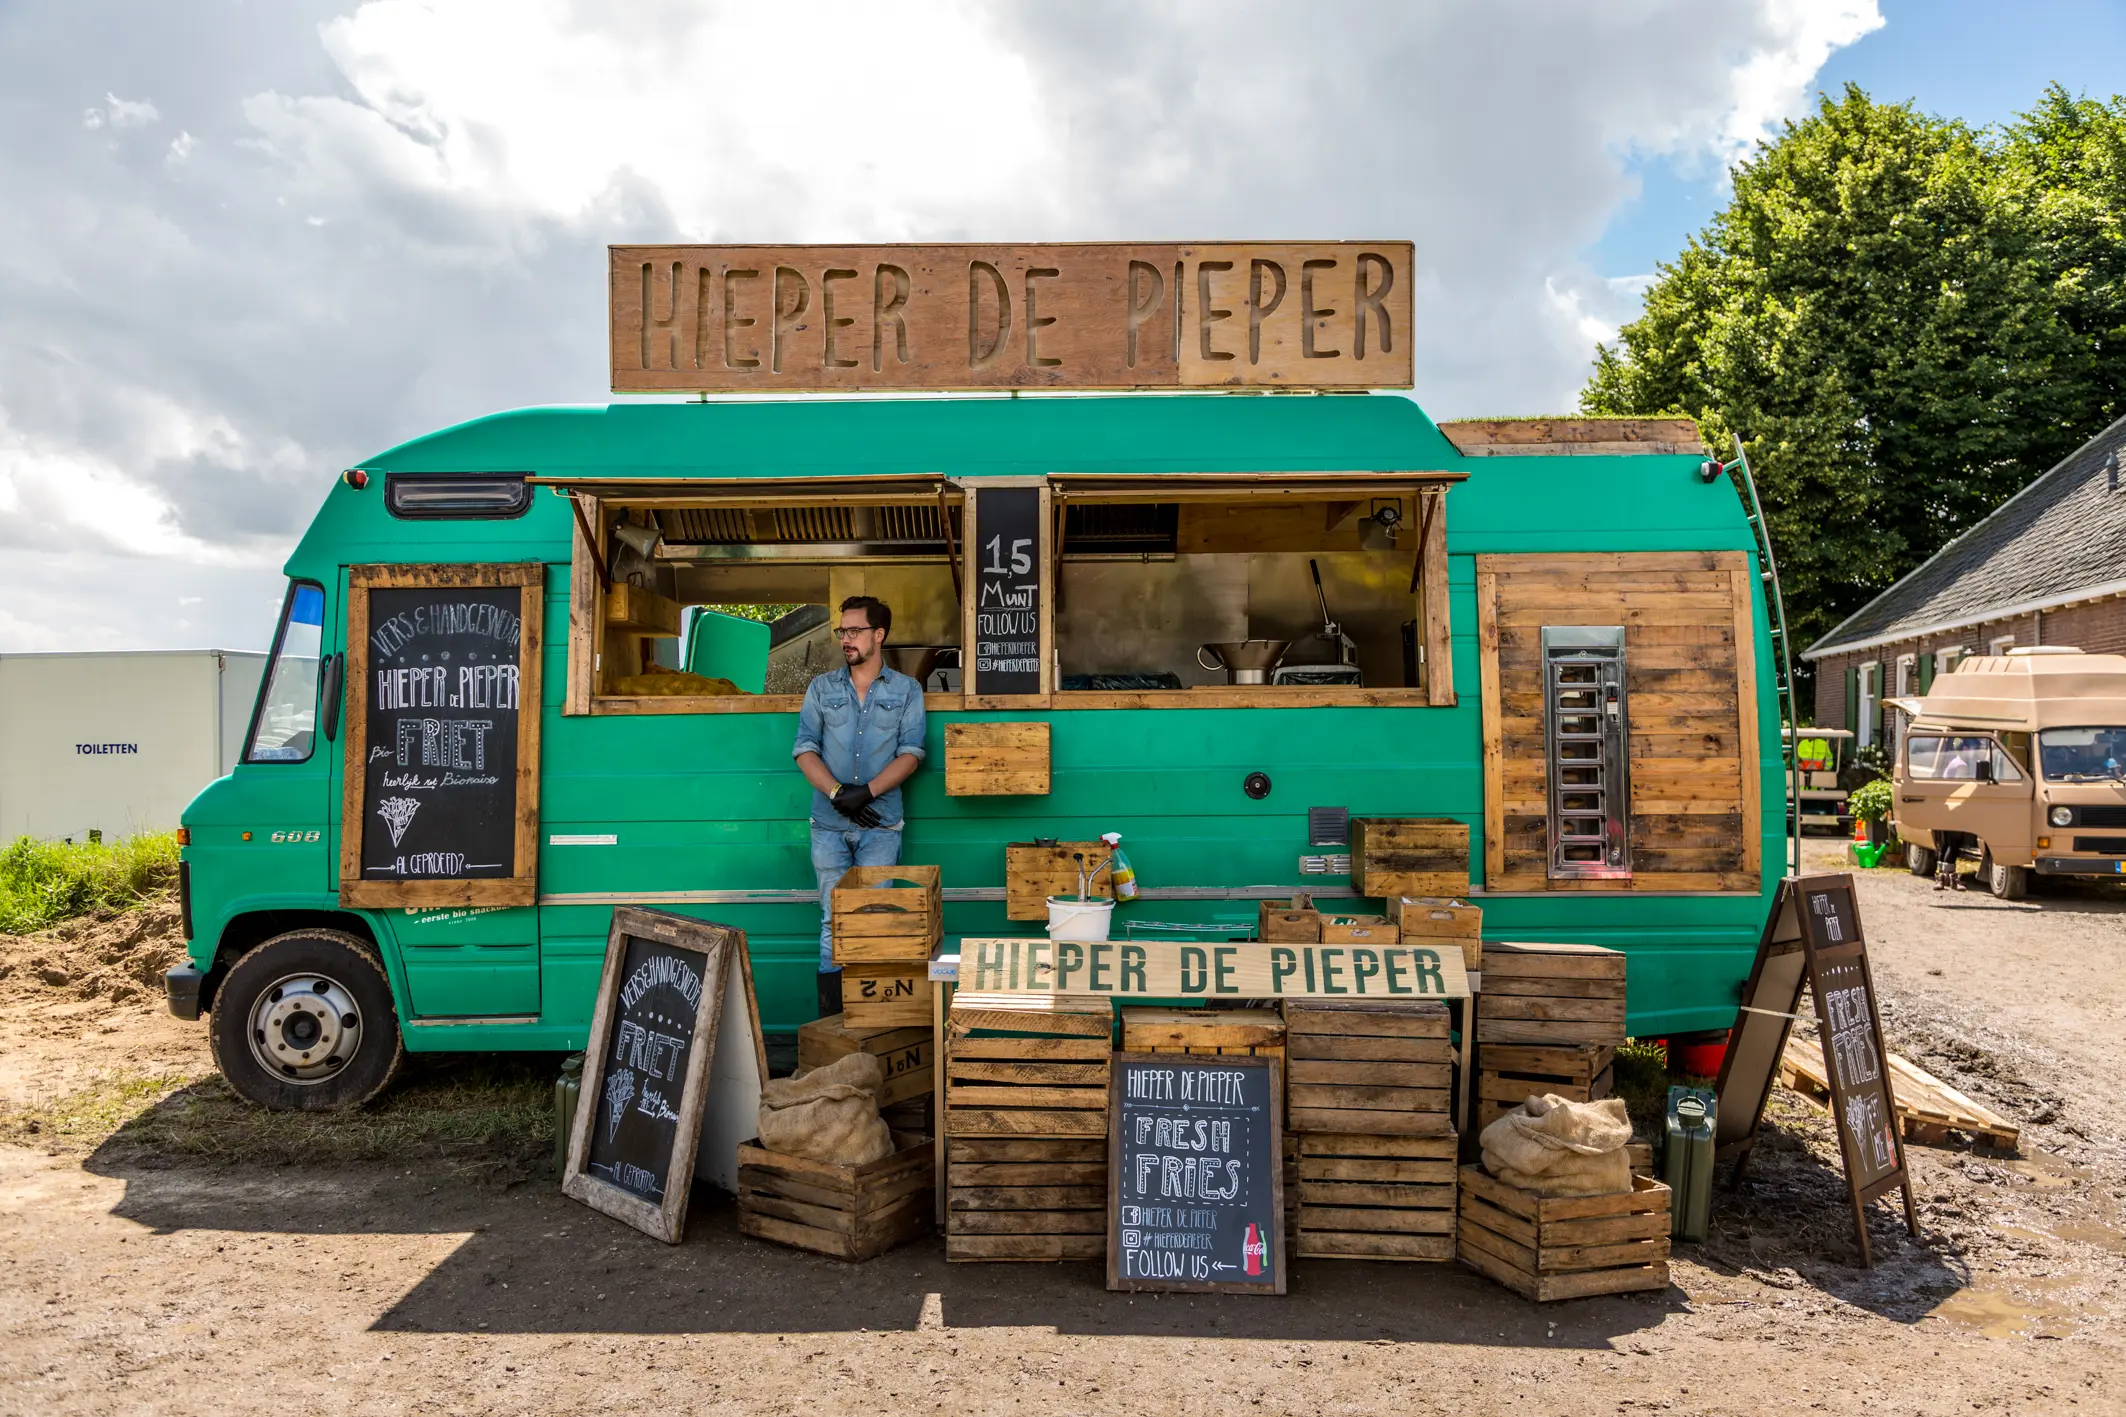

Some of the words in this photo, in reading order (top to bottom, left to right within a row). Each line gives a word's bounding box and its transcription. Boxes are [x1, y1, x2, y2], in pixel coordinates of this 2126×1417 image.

[641, 261, 910, 374] HIEPER
[968, 260, 1064, 370] DE
[1127, 252, 1395, 370] PIEPER
[370, 612, 415, 657] VERS
[978, 612, 1019, 636] FOLLOW
[1021, 611, 1037, 634] US
[378, 666, 447, 710] HIEPER
[449, 693, 460, 708] DE
[459, 665, 520, 709] PIEPER
[76, 743, 138, 755] TOILETTEN
[397, 718, 493, 770] FRIET
[270, 830, 321, 843] 608
[396, 855, 408, 874] AL
[410, 853, 465, 876] GEPROEFD?
[421, 913, 450, 924] eerste
[452, 910, 467, 919] bio
[976, 942, 1148, 993] HIEPER
[1180, 946, 1239, 993] DE
[1271, 946, 1447, 994] PIEPER
[620, 968, 646, 1010] VERS
[860, 979, 877, 998] 2
[1825, 986, 1871, 1032] FRESH
[1128, 1069, 1174, 1100] HIEPER
[1181, 1071, 1195, 1100] DE
[1198, 1071, 1245, 1105] PIEPER
[1135, 1116, 1231, 1153] FRESH
[1141, 1206, 1173, 1228] HIEPER
[1176, 1208, 1187, 1228] DE
[1190, 1209, 1218, 1230] PIEPER
[1126, 1249, 1185, 1277] FOLLOW
[1191, 1255, 1209, 1279] US
